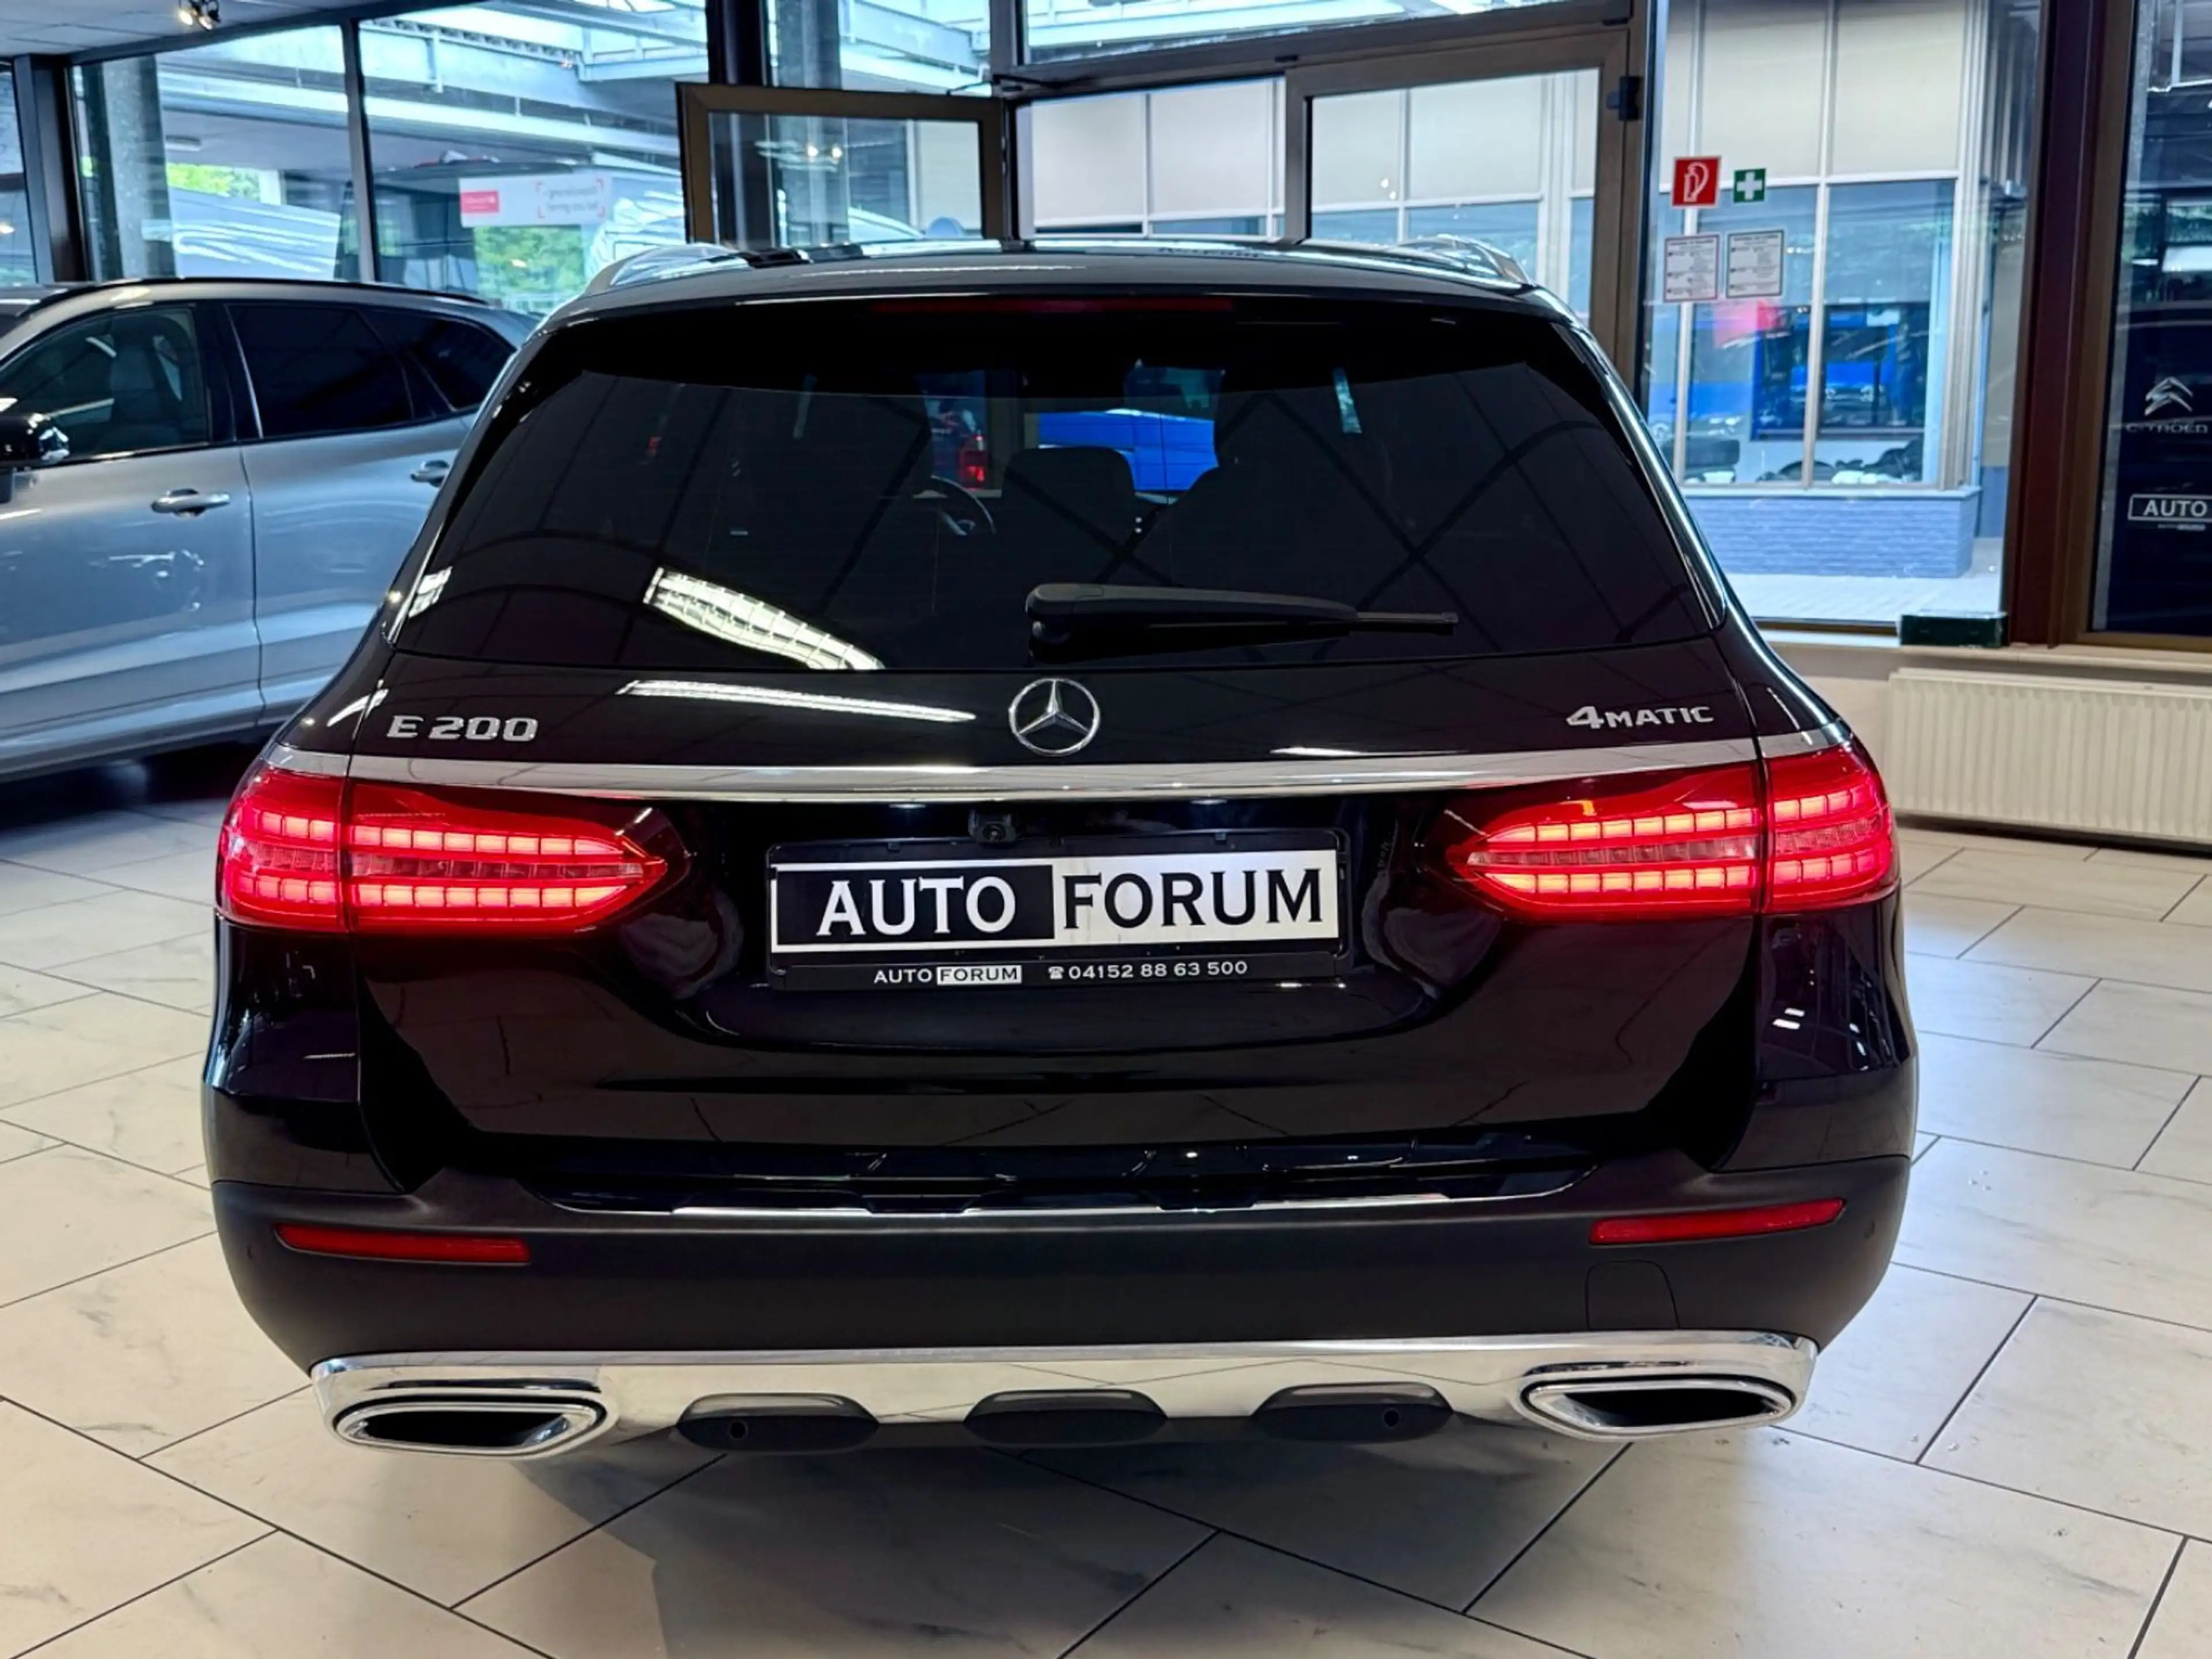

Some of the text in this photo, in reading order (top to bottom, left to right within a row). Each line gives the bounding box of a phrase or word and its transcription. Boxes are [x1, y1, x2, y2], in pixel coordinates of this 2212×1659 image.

[2143, 499, 2207, 517] AUTO
[386, 715, 538, 741] E 200
[1566, 706, 1714, 729] 4MATIC
[816, 868, 1323, 936] AUTO FORUM
[873, 961, 1248, 984] AUTO FORUM 04152 88 63 500
